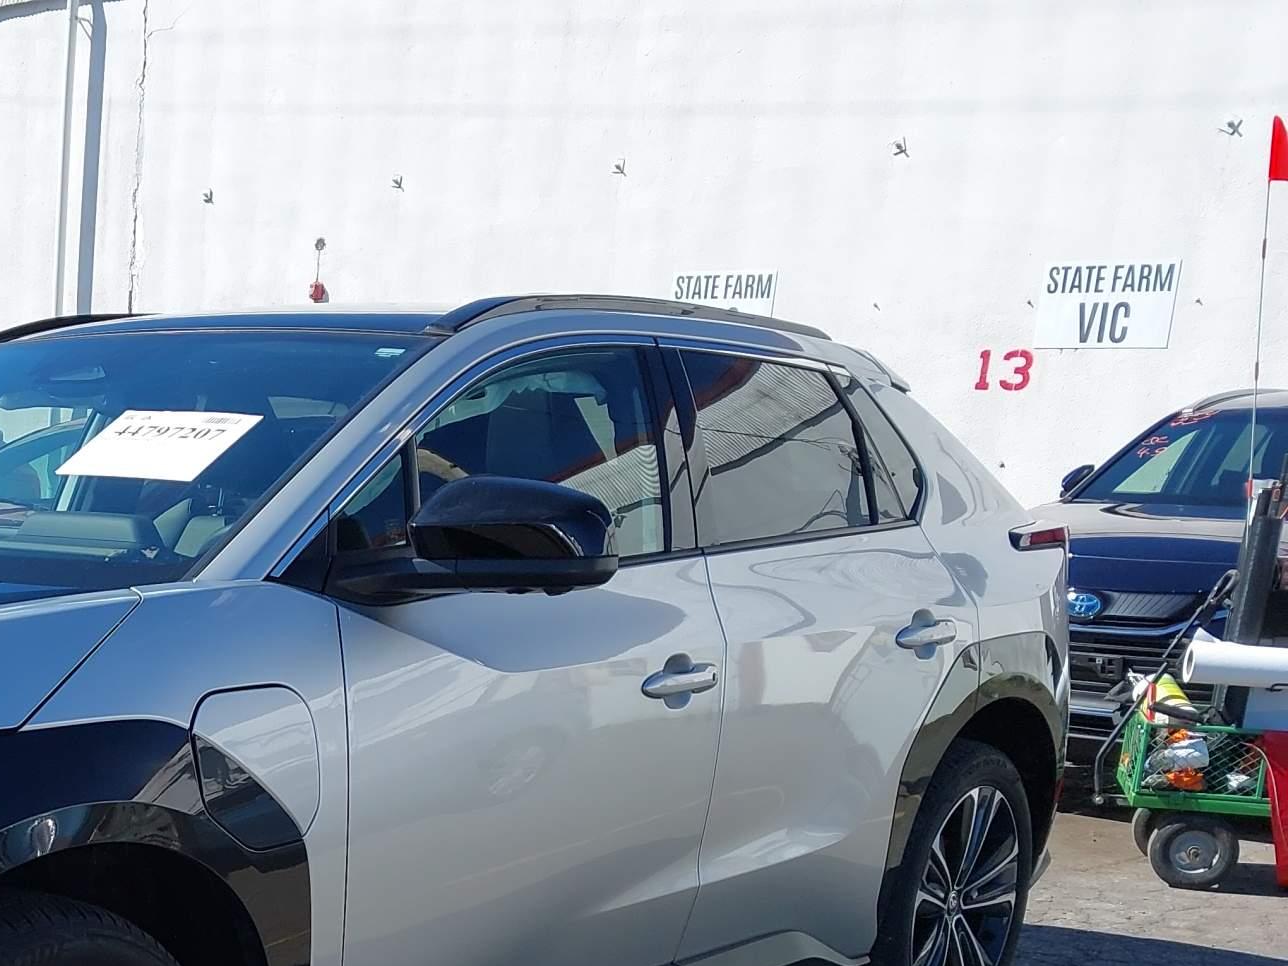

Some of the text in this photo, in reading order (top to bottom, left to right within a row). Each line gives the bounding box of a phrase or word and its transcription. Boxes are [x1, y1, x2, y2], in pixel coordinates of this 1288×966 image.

[674, 273, 773, 300] STATE FARM
[1047, 263, 1176, 294] STATE FARM
[1078, 301, 1131, 344] VIC
[974, 349, 1034, 391] 13
[114, 425, 227, 441] 44797207
